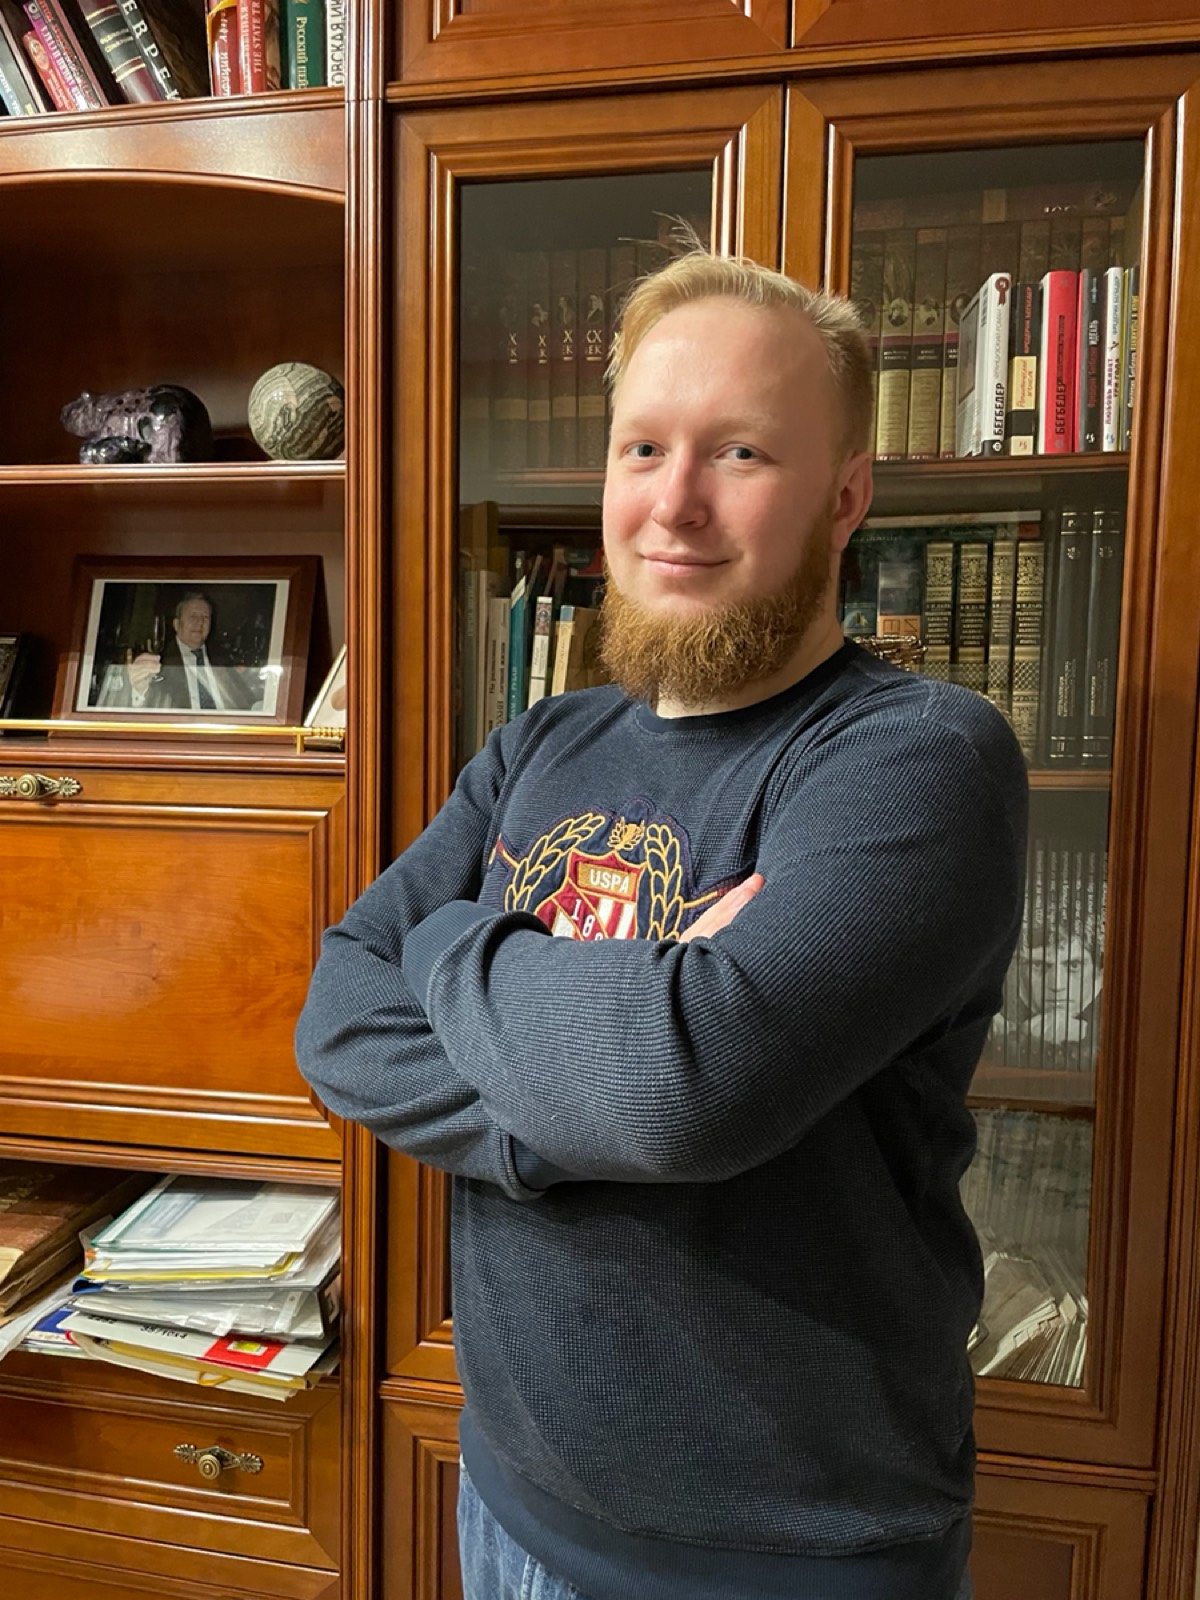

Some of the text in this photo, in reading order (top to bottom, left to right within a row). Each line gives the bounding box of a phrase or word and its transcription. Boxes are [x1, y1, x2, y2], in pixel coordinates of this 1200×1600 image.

[252, 17, 261, 49] STATE
[296, 16, 308, 64] Русский
[253, 51, 262, 73] THE
[1088, 319, 1098, 345] ИДЕАЛЬ
[993, 382, 1005, 436] БЕГБЕДЕР
[1055, 381, 1066, 434] БЕГБЕДЕР
[1105, 388, 1113, 424] ЛЮБОВЬ
[589, 868, 631, 893] USPA
